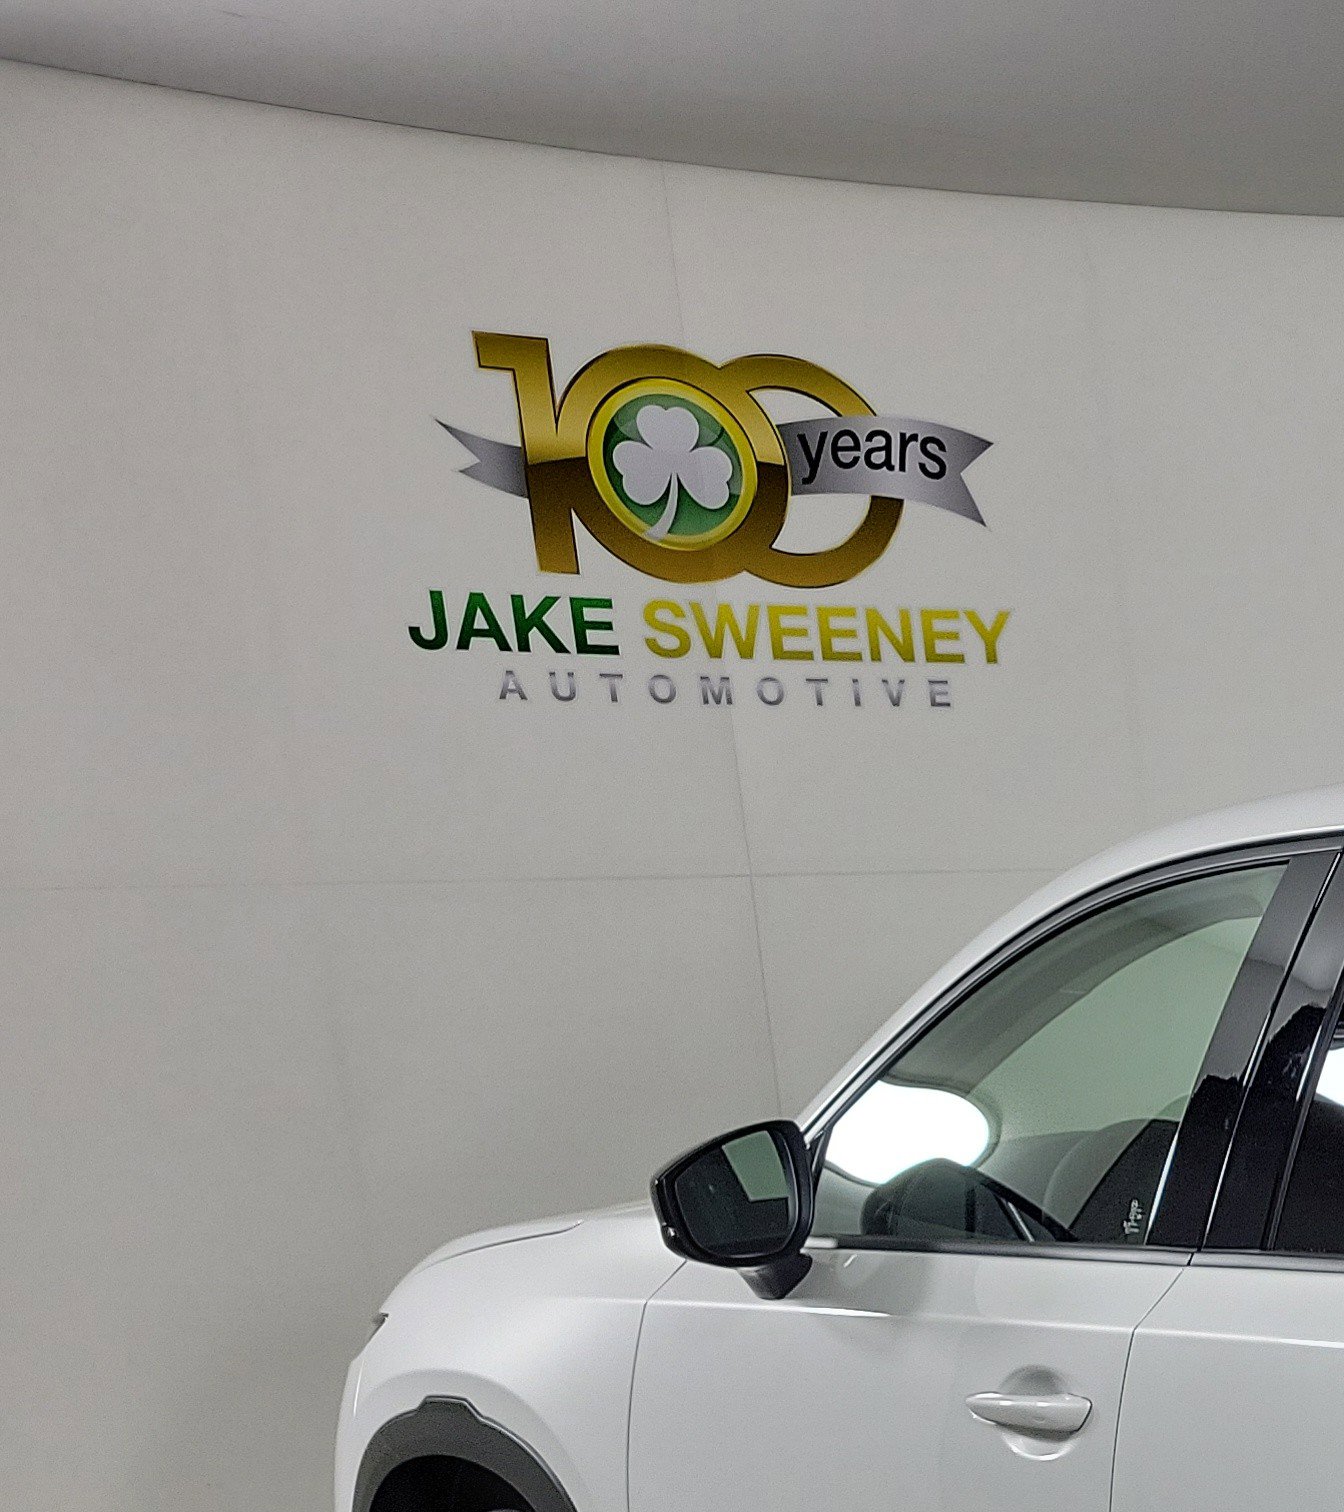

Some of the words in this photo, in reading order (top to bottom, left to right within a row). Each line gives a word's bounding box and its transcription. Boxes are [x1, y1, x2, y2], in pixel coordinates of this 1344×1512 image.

[796, 428, 948, 486] years
[408, 589, 621, 656] JAKE
[642, 598, 1012, 666] SWEENEY
[499, 669, 952, 709] AUTOMOTIVE
